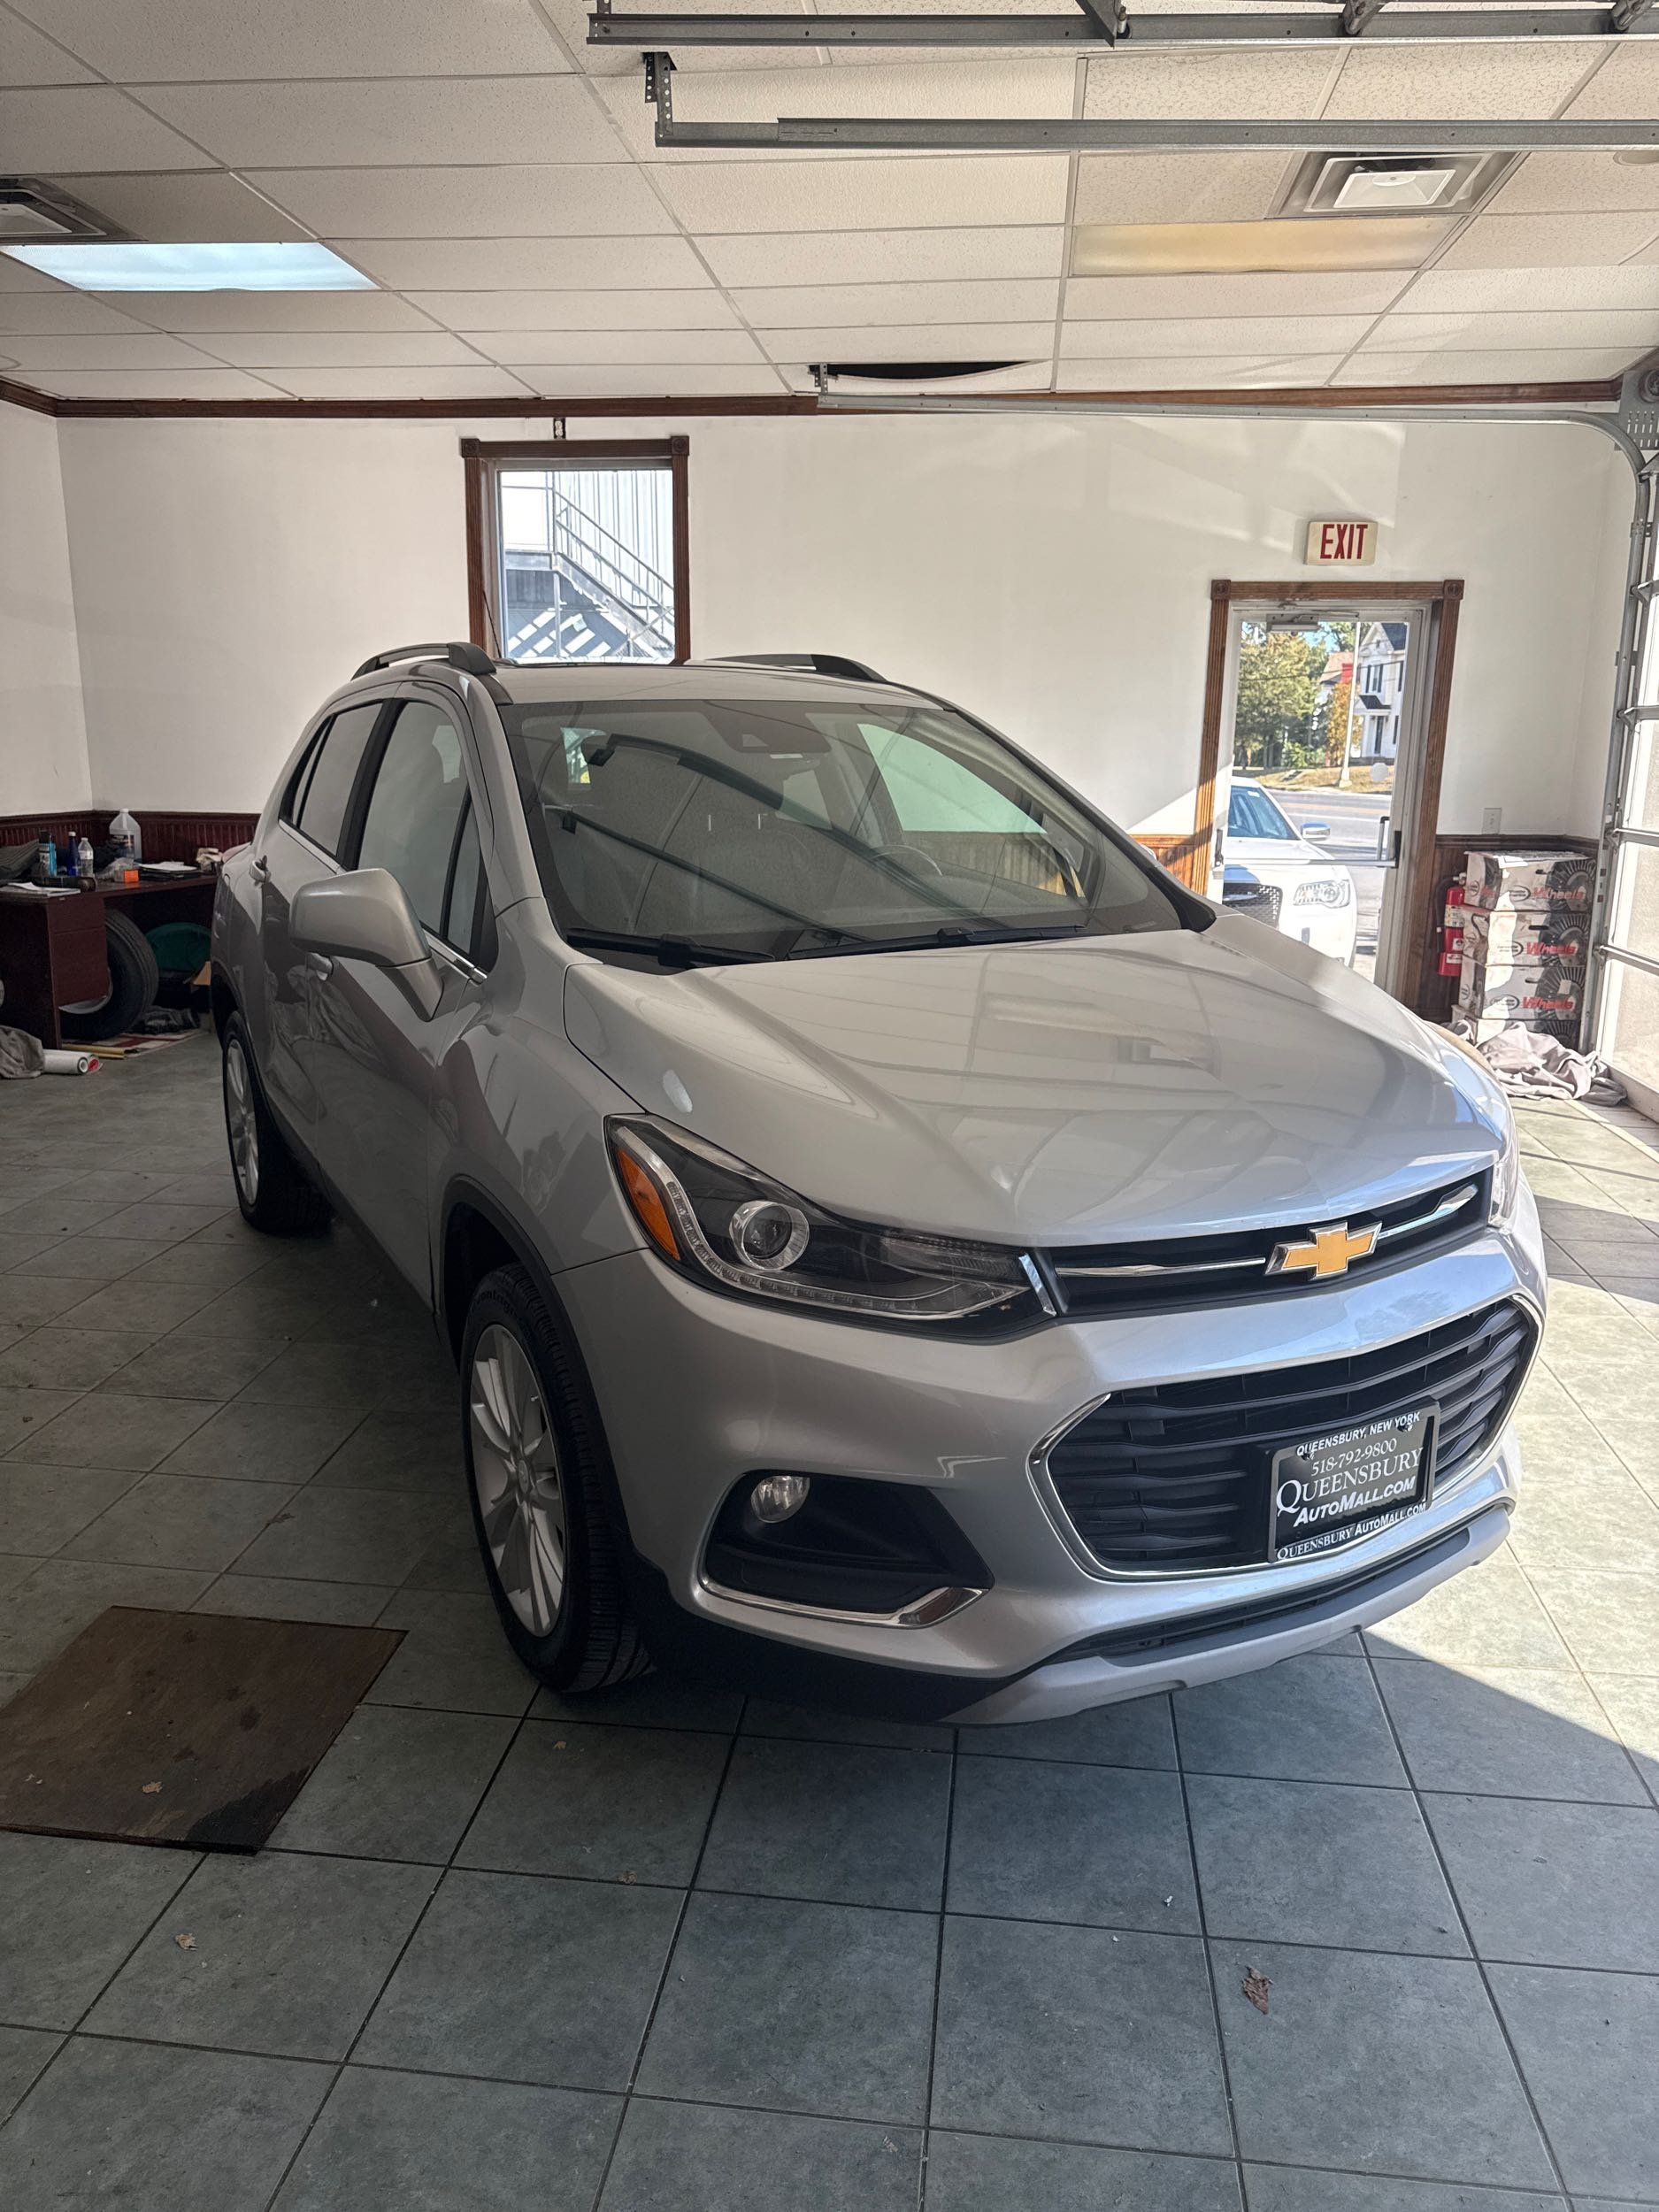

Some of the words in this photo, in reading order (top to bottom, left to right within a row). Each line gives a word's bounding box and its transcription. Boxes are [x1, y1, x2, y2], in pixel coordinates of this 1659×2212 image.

[1320, 524, 1368, 559] EXIT
[1532, 887, 1585, 900] Wheels
[1526, 941, 1577, 955] Wheels
[1523, 996, 1574, 1010] Wheels
[1369, 1419, 1393, 1435] NEW
[1394, 1411, 1420, 1428] YORK
[1310, 1437, 1397, 1476] 518-792-9800
[1276, 1447, 1424, 1517] QUEENSBURY
[1277, 1527, 1354, 1560] QUEENSBURY
